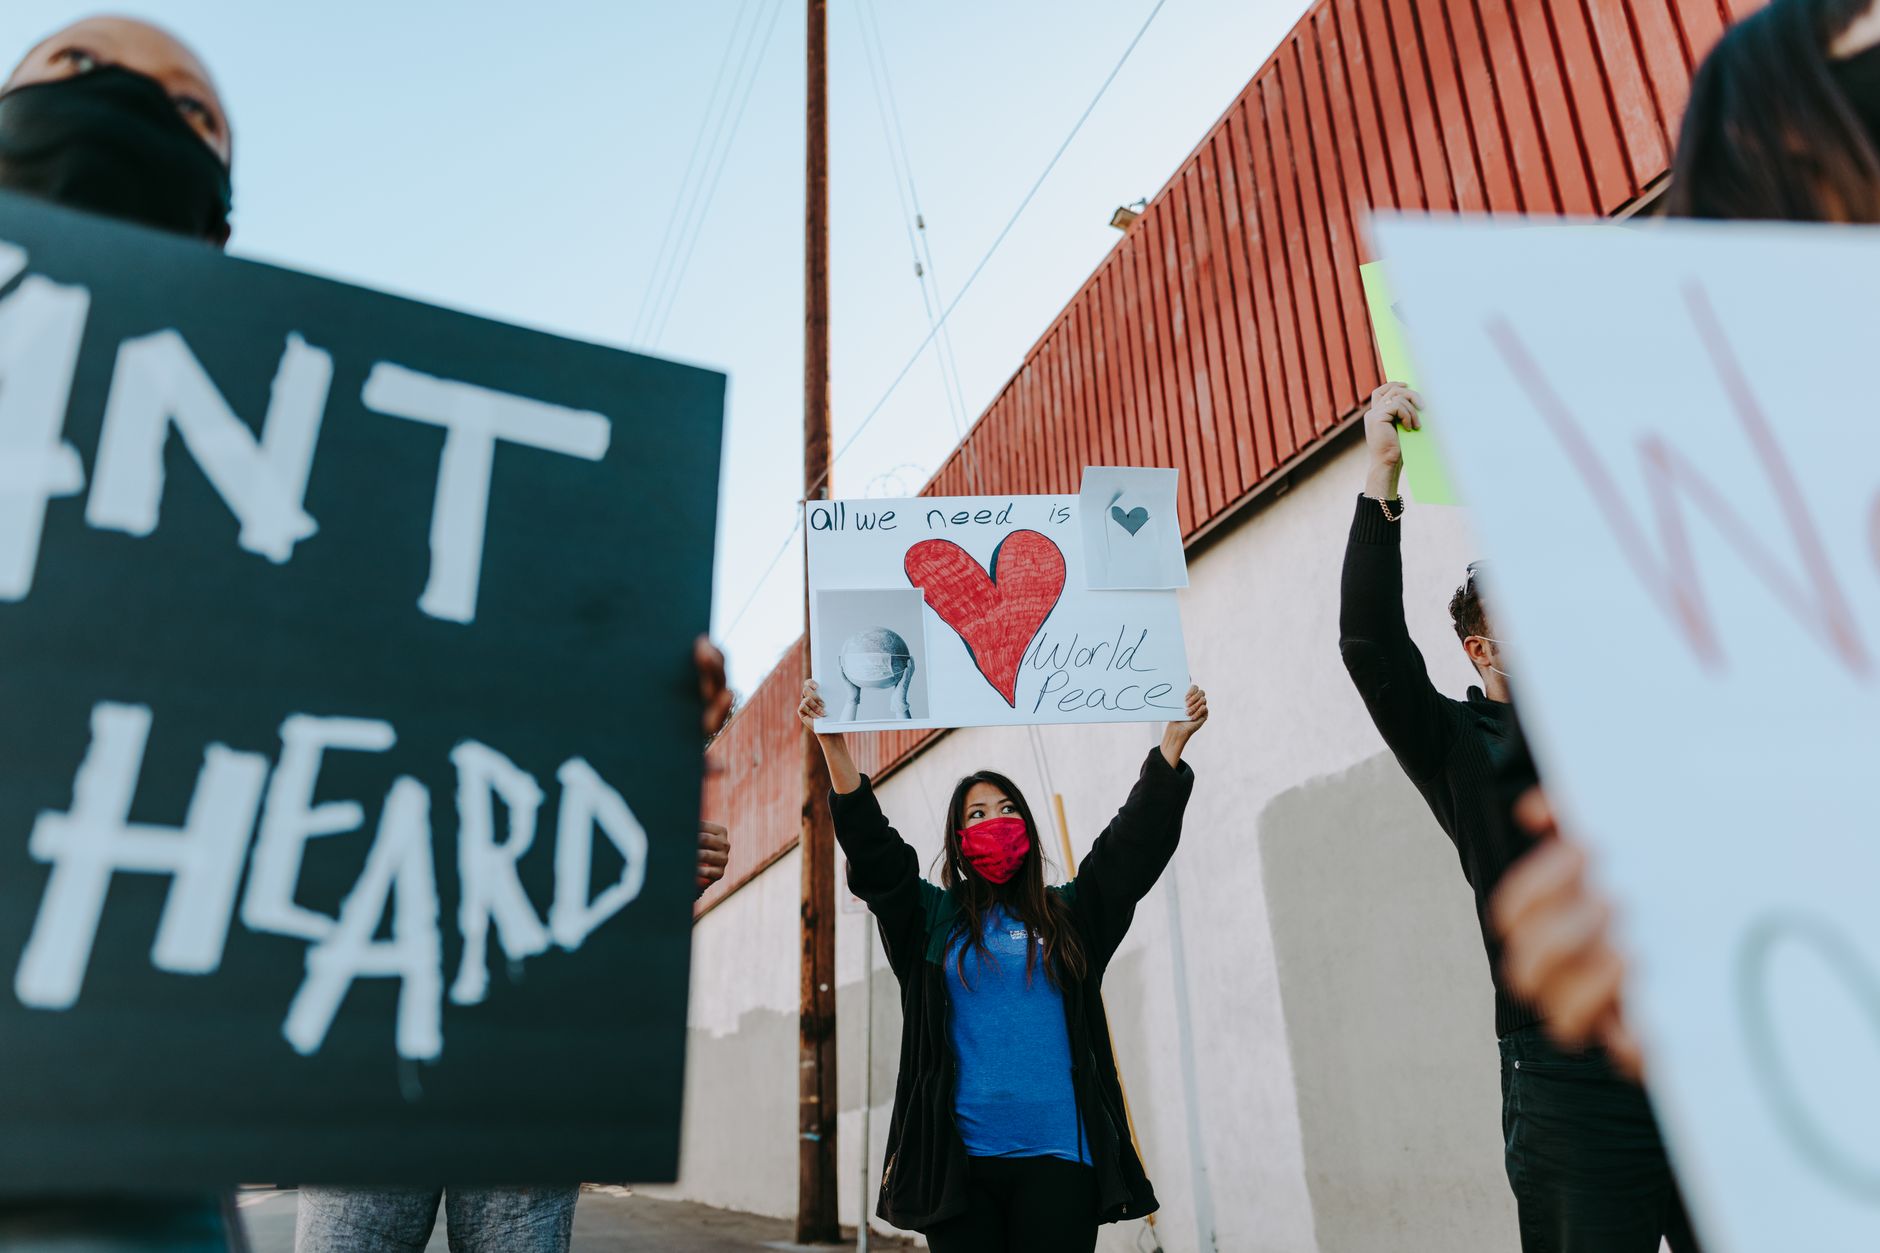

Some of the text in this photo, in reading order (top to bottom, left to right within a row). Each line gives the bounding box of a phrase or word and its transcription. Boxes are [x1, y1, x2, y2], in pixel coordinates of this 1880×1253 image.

[810, 502, 1071, 531] all we need is
[1025, 625, 1158, 671] World
[1033, 671, 1185, 714] Peace
[14, 700, 648, 1061] HEARD
